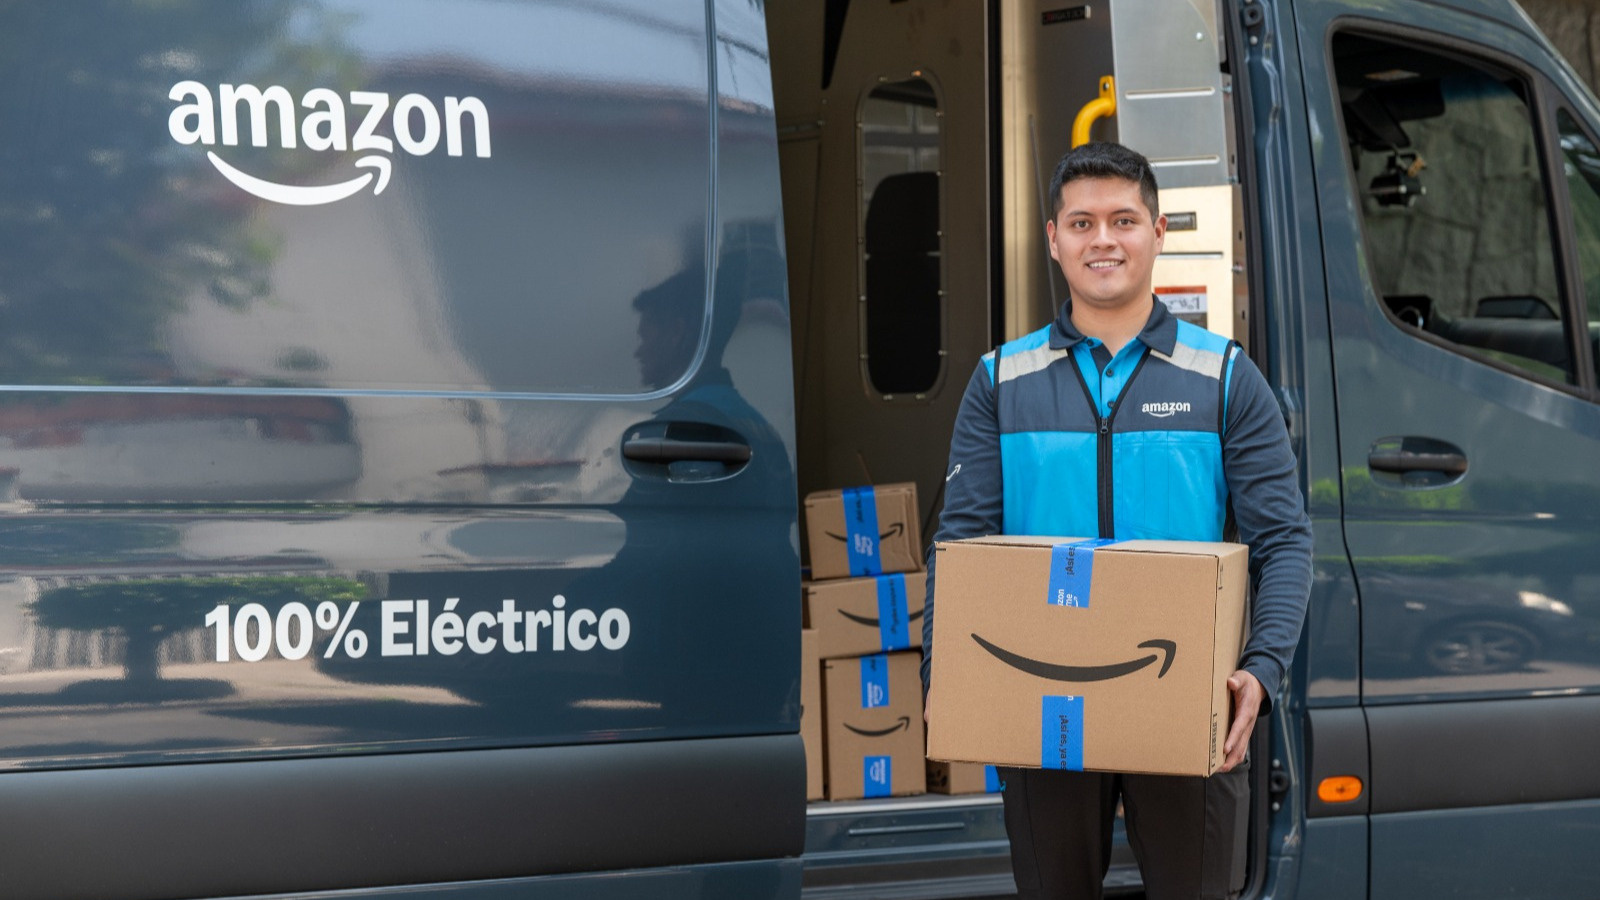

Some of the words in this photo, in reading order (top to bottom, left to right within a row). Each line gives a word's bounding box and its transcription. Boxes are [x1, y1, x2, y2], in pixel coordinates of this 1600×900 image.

[168, 80, 491, 158] amazon
[1142, 402, 1191, 413] amazon
[205, 601, 367, 663] 100%
[381, 595, 630, 657] Eléctrico
